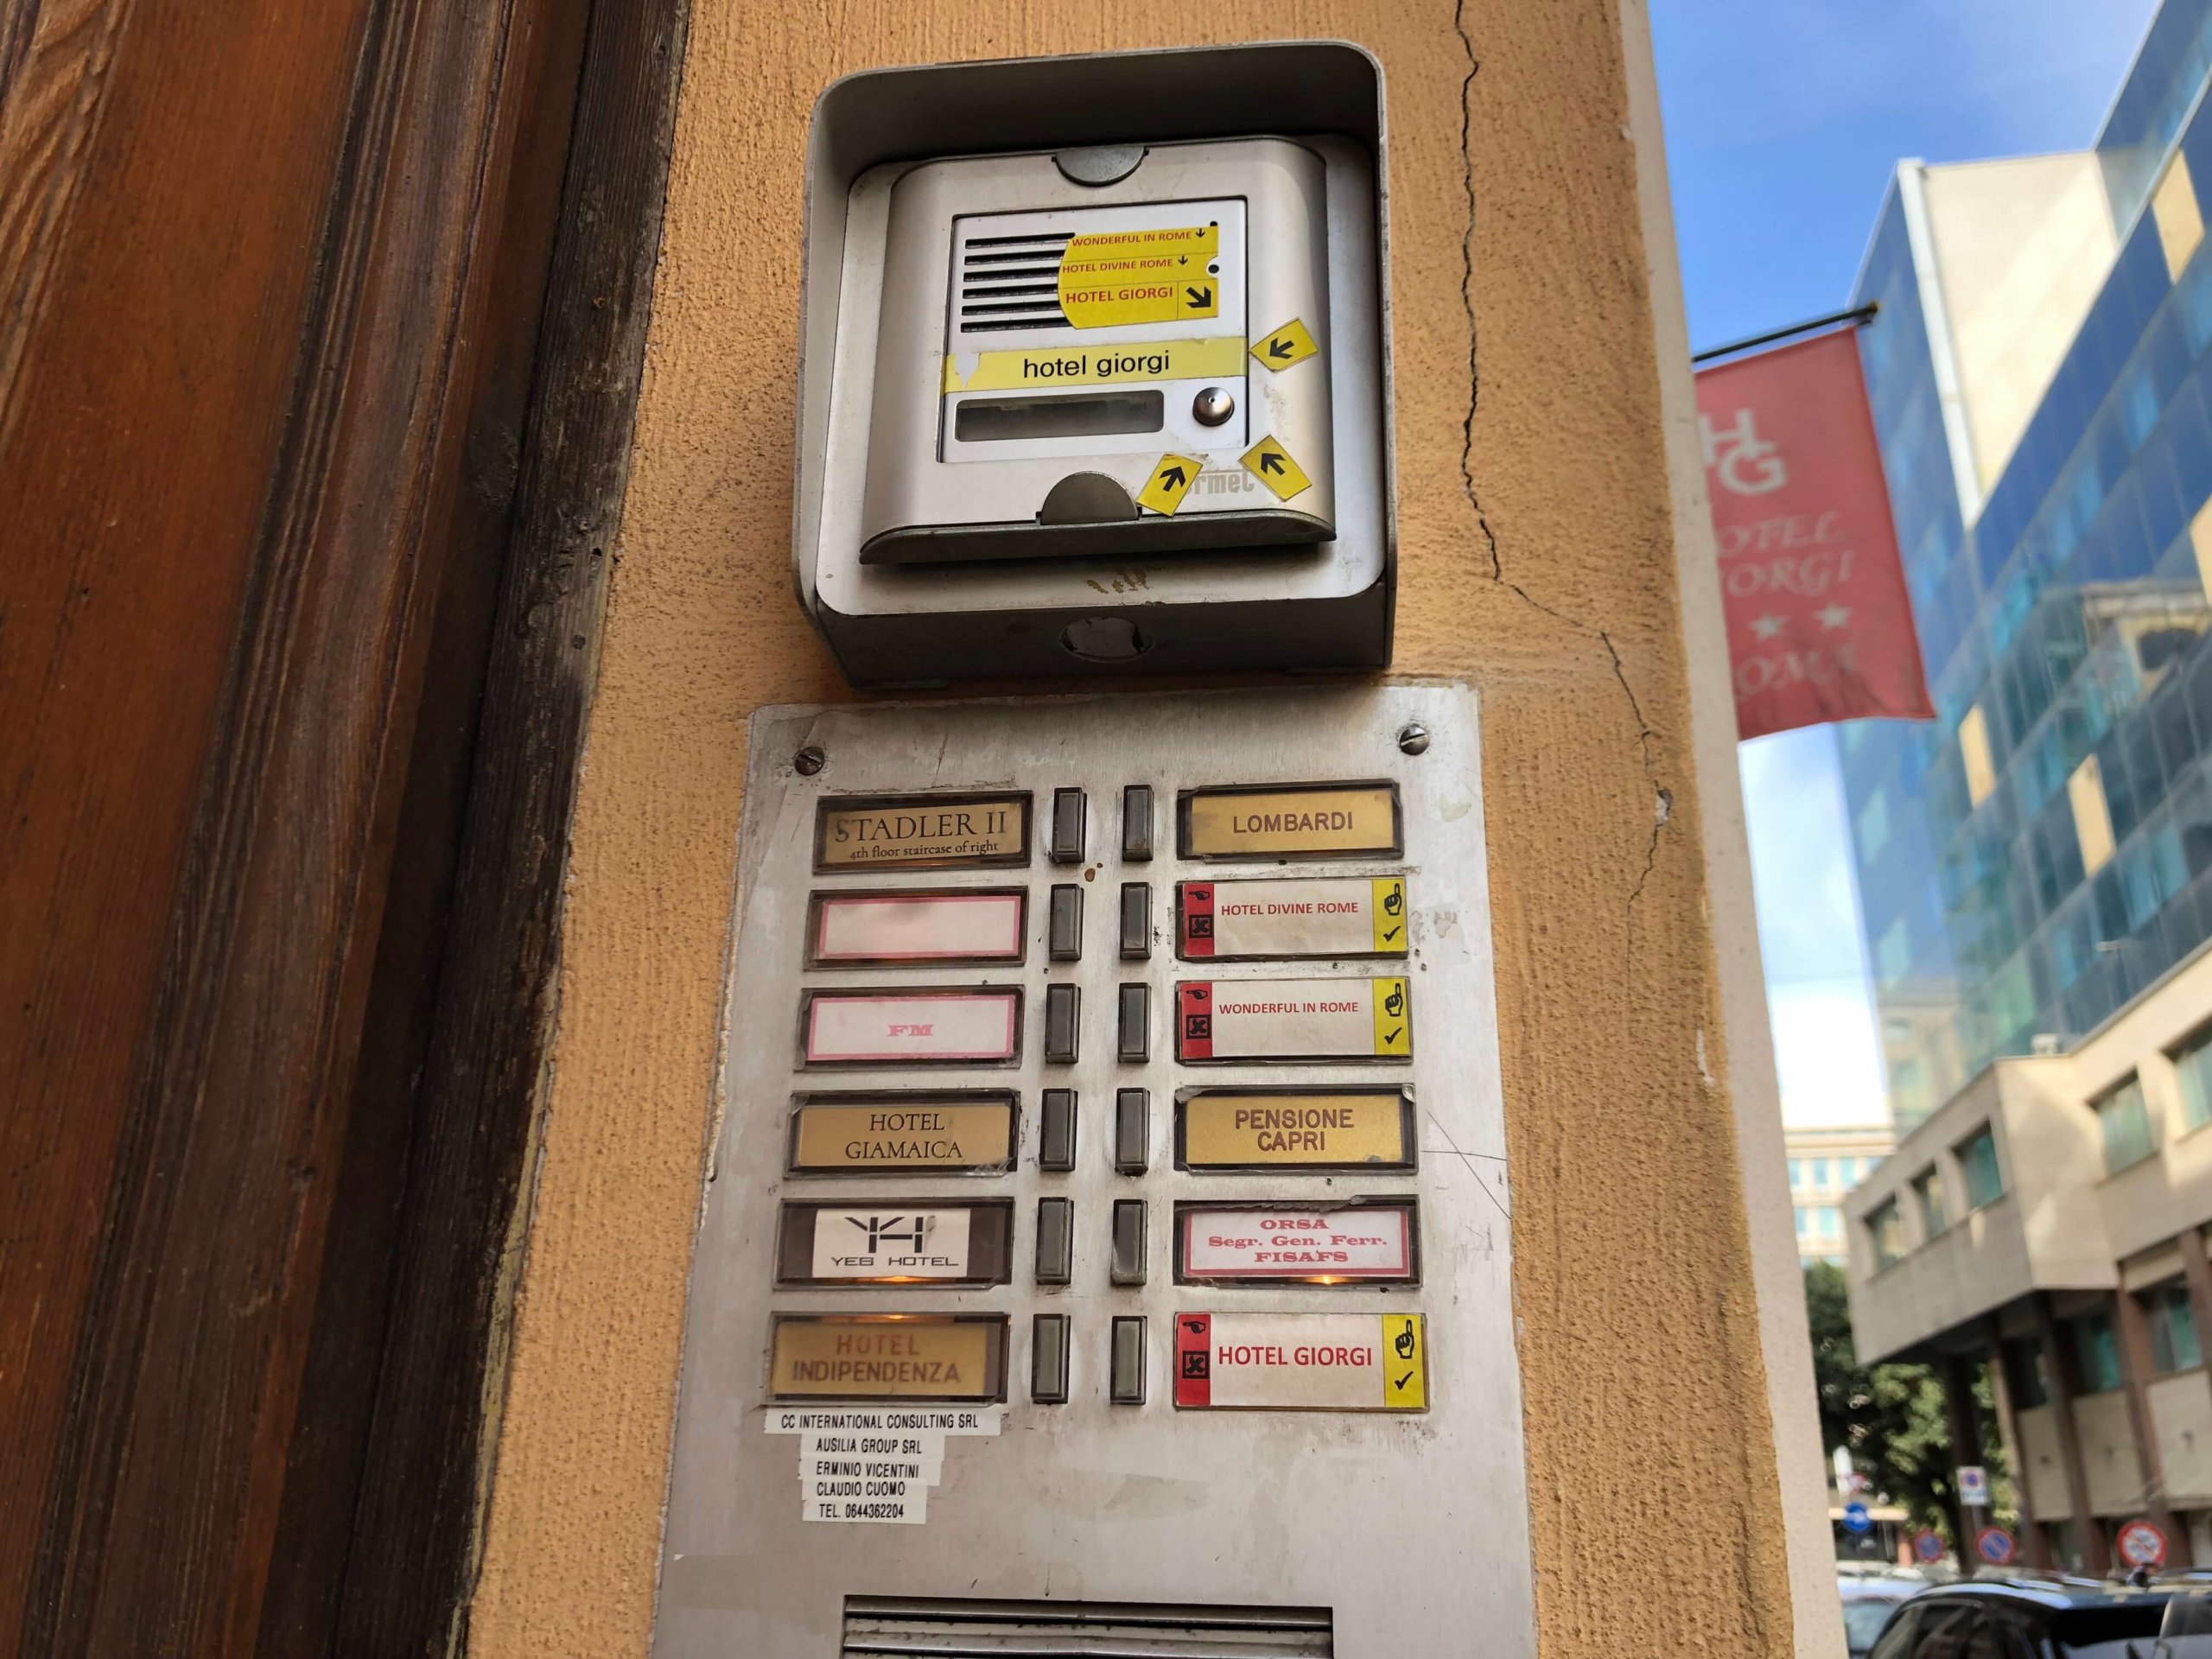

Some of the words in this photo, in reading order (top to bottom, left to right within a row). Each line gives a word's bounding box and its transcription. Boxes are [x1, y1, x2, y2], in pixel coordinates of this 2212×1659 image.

[1071, 234, 1141, 247] WONDERFUL
[1144, 232, 1155, 242] IN
[1159, 231, 1192, 241] ROME
[1062, 263, 1097, 274] HOTEL
[1100, 260, 1136, 271] DIVINE
[1140, 258, 1173, 269] ROME
[1065, 290, 1114, 304] HOTEL
[1118, 286, 1173, 300] GIORGI
[1023, 354, 1086, 378] hotel
[1096, 350, 1169, 378] giorgi
[1185, 466, 1255, 495] rmet
[1716, 511, 1845, 558] OTEL
[835, 812, 979, 842] STADLER
[986, 810, 1007, 834] II
[1232, 810, 1353, 834] LOMBARDI
[850, 848, 868, 861] 4th
[872, 845, 899, 858] floor
[903, 843, 951, 856] staircase
[955, 841, 970, 854] of
[970, 840, 999, 855] right
[1221, 904, 1264, 916] HOTEL
[1268, 903, 1313, 915] DIVINE
[1319, 902, 1358, 914] ROME
[1218, 1002, 1300, 1014] WONDERFUL
[1302, 1002, 1316, 1014] IN
[1319, 1001, 1359, 1013] ROME
[887, 1024, 934, 1037] FM
[869, 1113, 945, 1131] HOTEL
[1235, 1109, 1355, 1130] PENSIONE
[1257, 1131, 1325, 1152] CAPRI
[845, 1141, 963, 1160] GIAMAICA
[1260, 1219, 1330, 1230] ORSA
[1208, 1236, 1263, 1249] Segr.
[1271, 1236, 1321, 1246] Gen.
[1330, 1235, 1388, 1246] Ferr.
[830, 1256, 874, 1267] YES
[888, 1256, 959, 1267] HOTEL
[1254, 1251, 1349, 1263] FISAFS
[836, 1334, 921, 1357] HOTEL
[1218, 1346, 1287, 1365] HOTEL
[1294, 1346, 1372, 1366] GIORGI
[792, 1360, 962, 1383] INDIPENDENZA
[781, 1414, 796, 1428] CC
[799, 1414, 883, 1429] INTERNATIONAL
[887, 1414, 954, 1429] CONSULTING
[958, 1414, 978, 1428] SRL
[816, 1438, 857, 1452] AUSILIA
[861, 1438, 899, 1453] GROUP
[902, 1440, 923, 1454] SRL
[817, 1461, 861, 1477] ERMINIO
[866, 1463, 919, 1478] VICENTINI
[817, 1481, 862, 1496] CLAUDIO
[866, 1481, 906, 1496] CUOMO
[819, 1503, 842, 1518] TEL.
[845, 1503, 905, 1518] 0644362204
